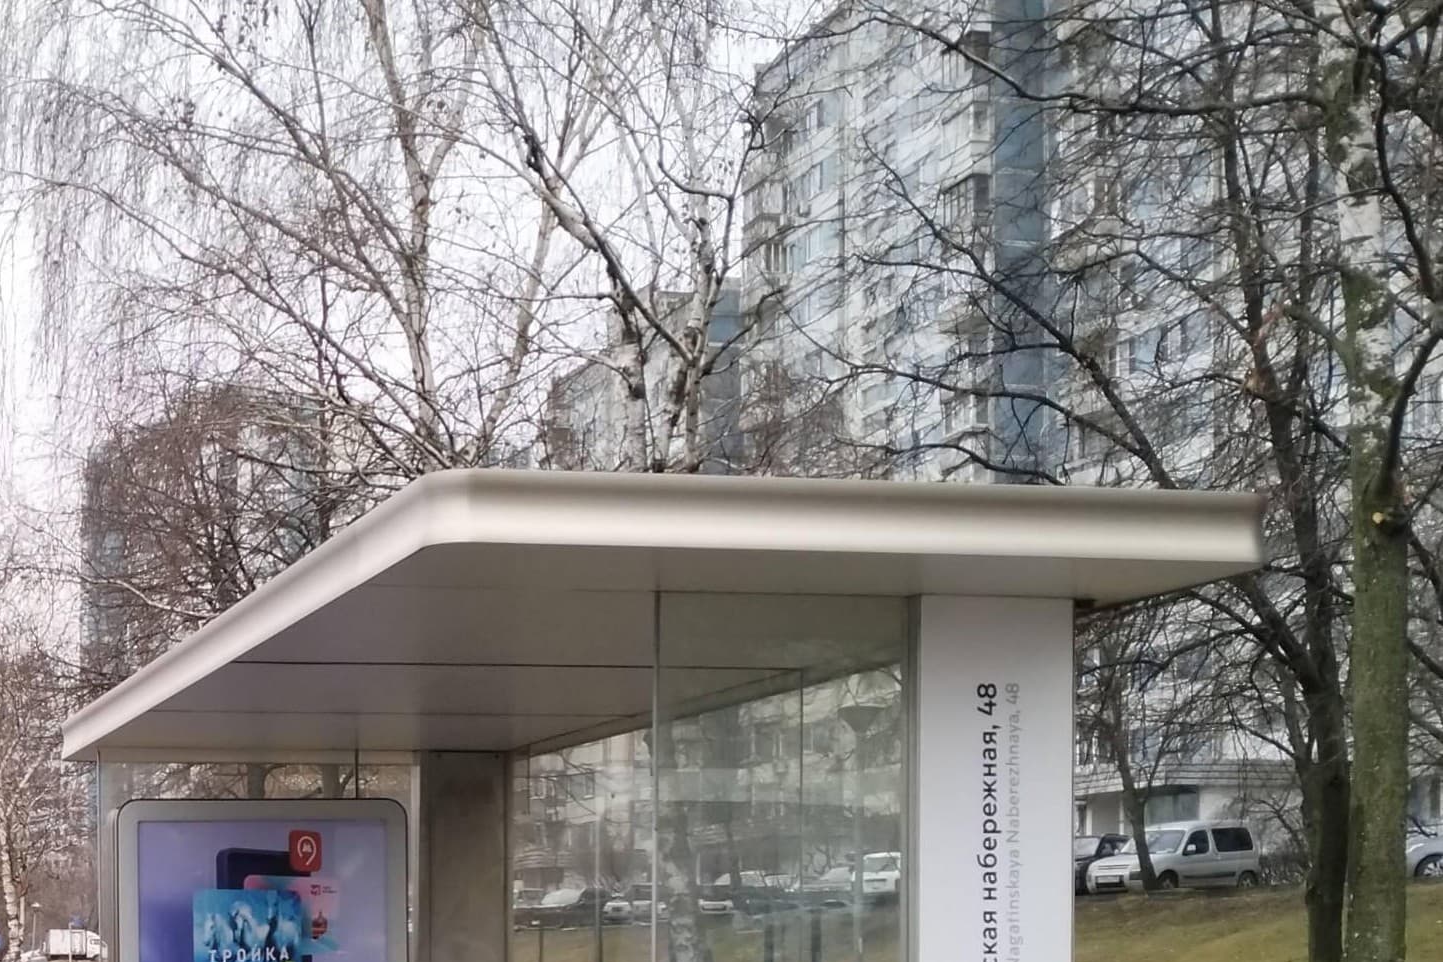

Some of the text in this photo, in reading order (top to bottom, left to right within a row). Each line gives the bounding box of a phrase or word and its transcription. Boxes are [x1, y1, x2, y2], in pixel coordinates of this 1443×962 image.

[976, 683, 998, 716] 48
[1005, 682, 1021, 705] 48
[977, 724, 1003, 901] набережная,
[1005, 710, 1023, 843] Naberezhnaya,
